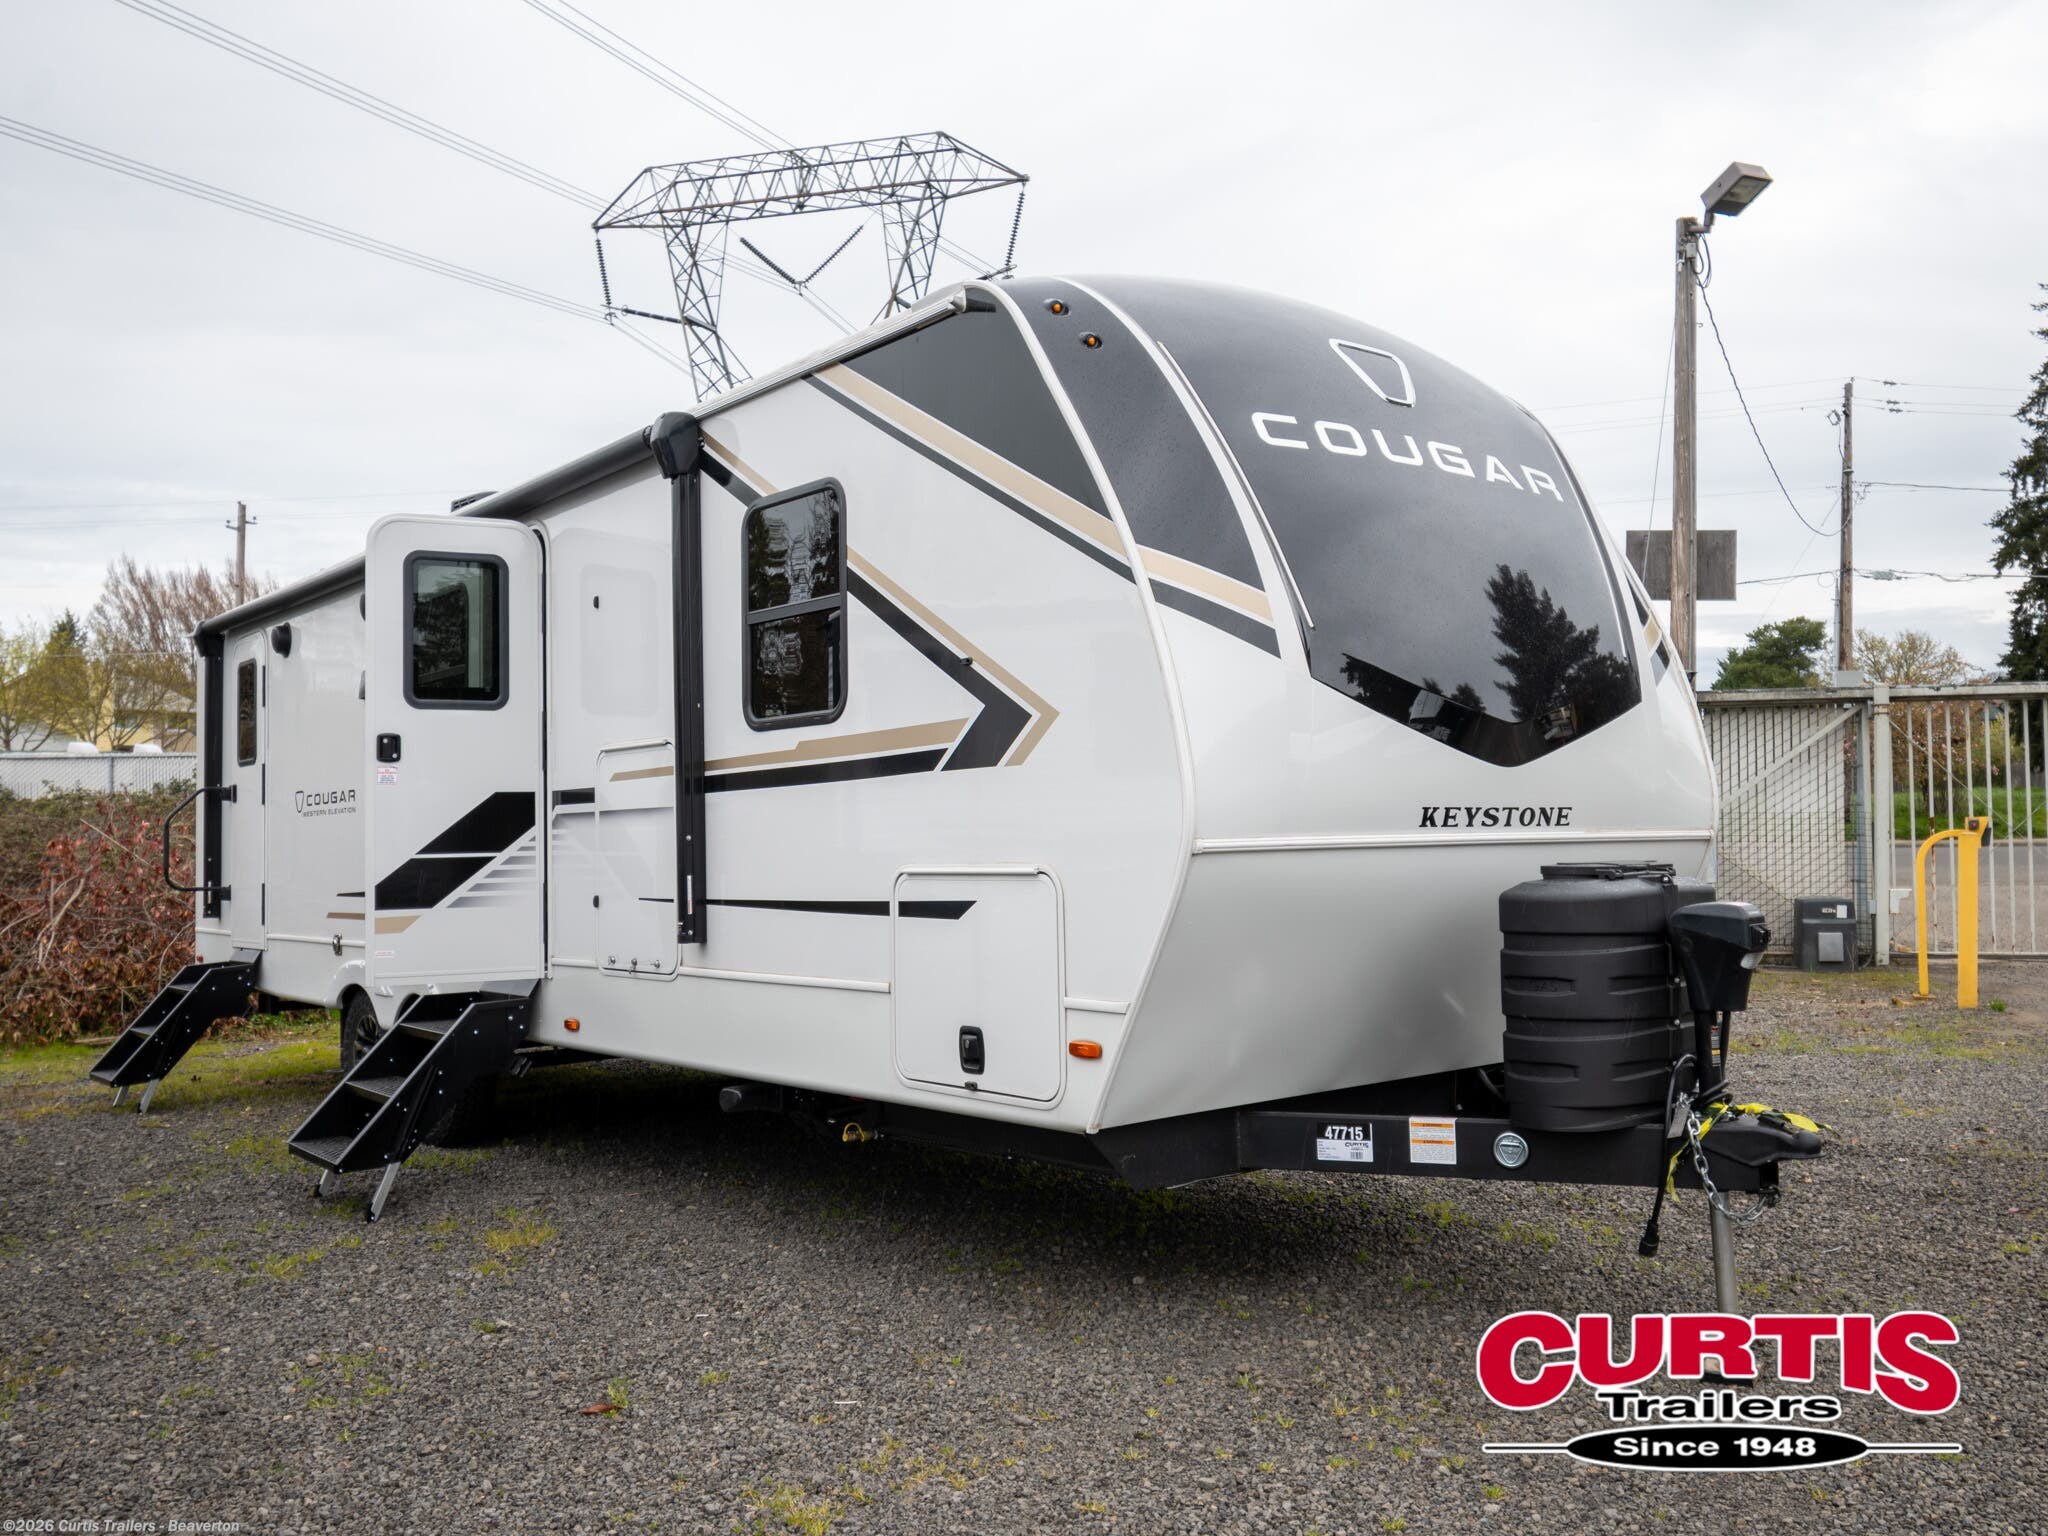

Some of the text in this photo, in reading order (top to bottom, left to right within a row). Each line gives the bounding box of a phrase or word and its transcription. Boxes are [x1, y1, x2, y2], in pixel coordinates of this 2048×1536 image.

[1251, 411, 1564, 503] COUGAR
[306, 789, 356, 807] COUGAR
[303, 806, 357, 818] WESTERN ELEVATION
[1418, 806, 1573, 828] KEYSTONE
[1324, 1125, 1364, 1141] 47715
[1344, 1141, 1369, 1149] CURTIS
